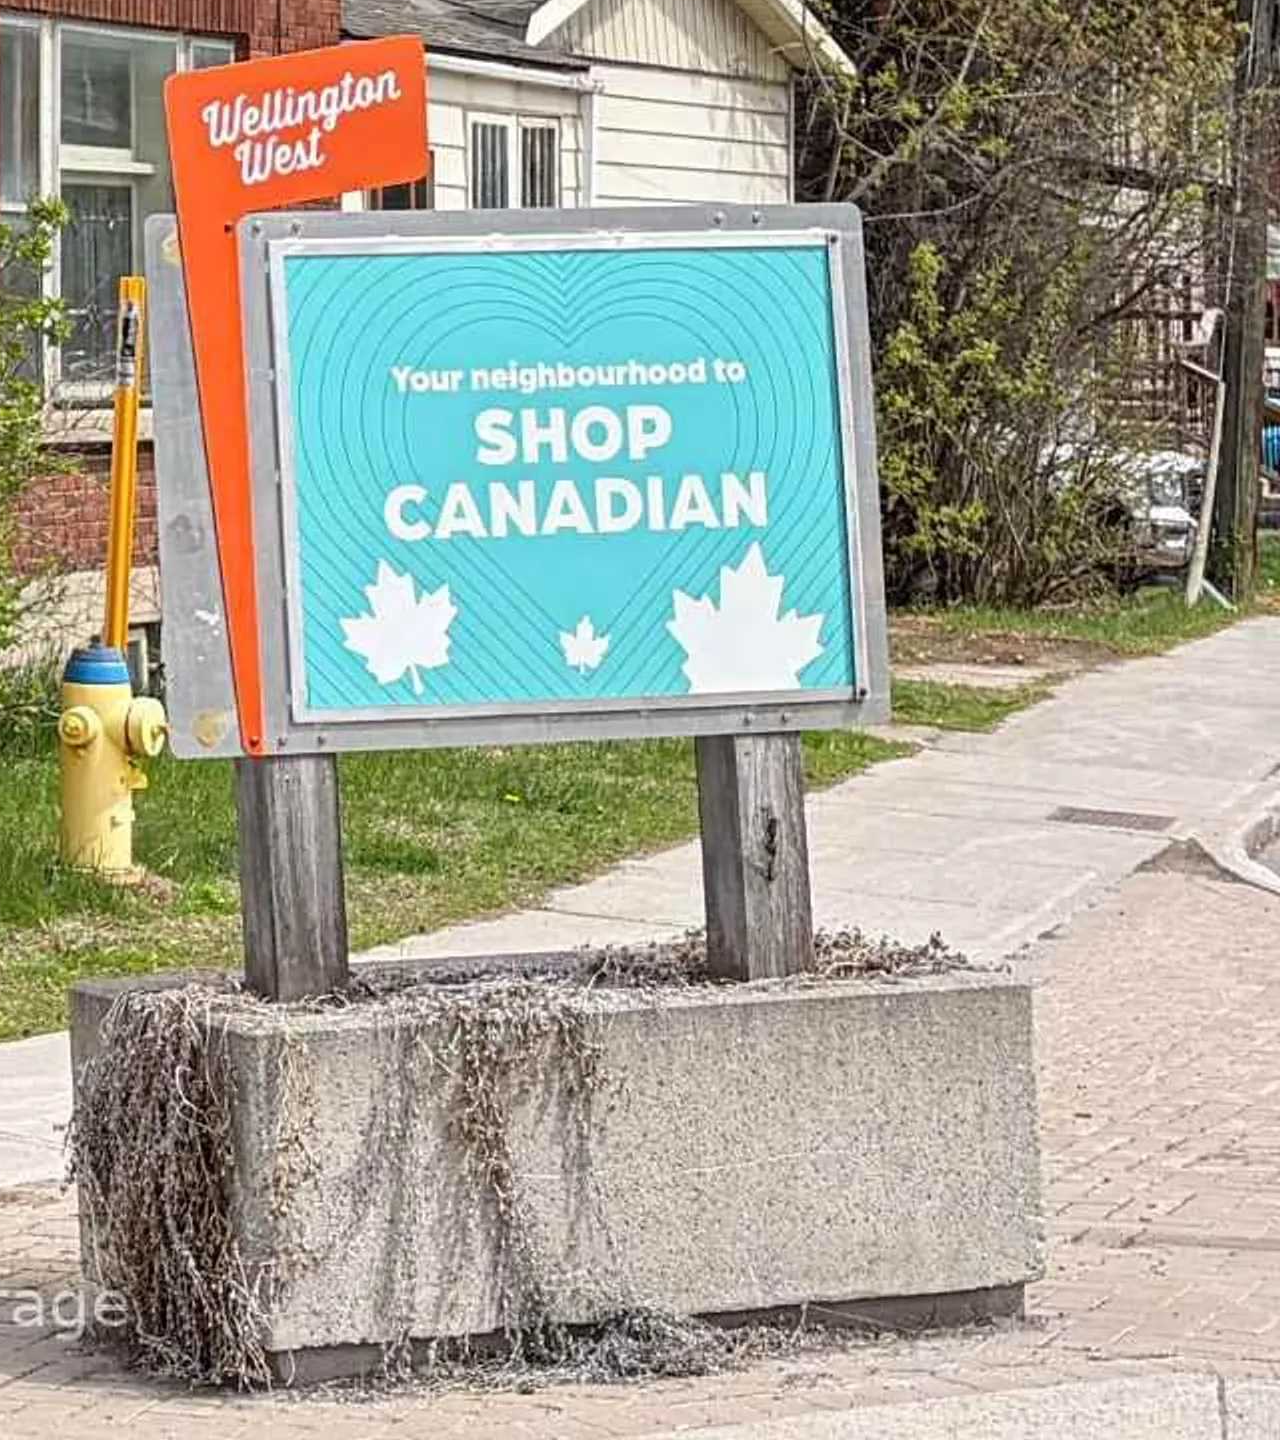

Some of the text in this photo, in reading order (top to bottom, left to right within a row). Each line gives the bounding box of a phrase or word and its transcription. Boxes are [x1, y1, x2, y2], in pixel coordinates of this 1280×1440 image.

[201, 70, 402, 146] Wellington
[234, 127, 325, 186] West
[390, 358, 746, 393] Your neighbourhood to
[474, 404, 673, 466] SHOP
[383, 471, 769, 541] CANADIAN
